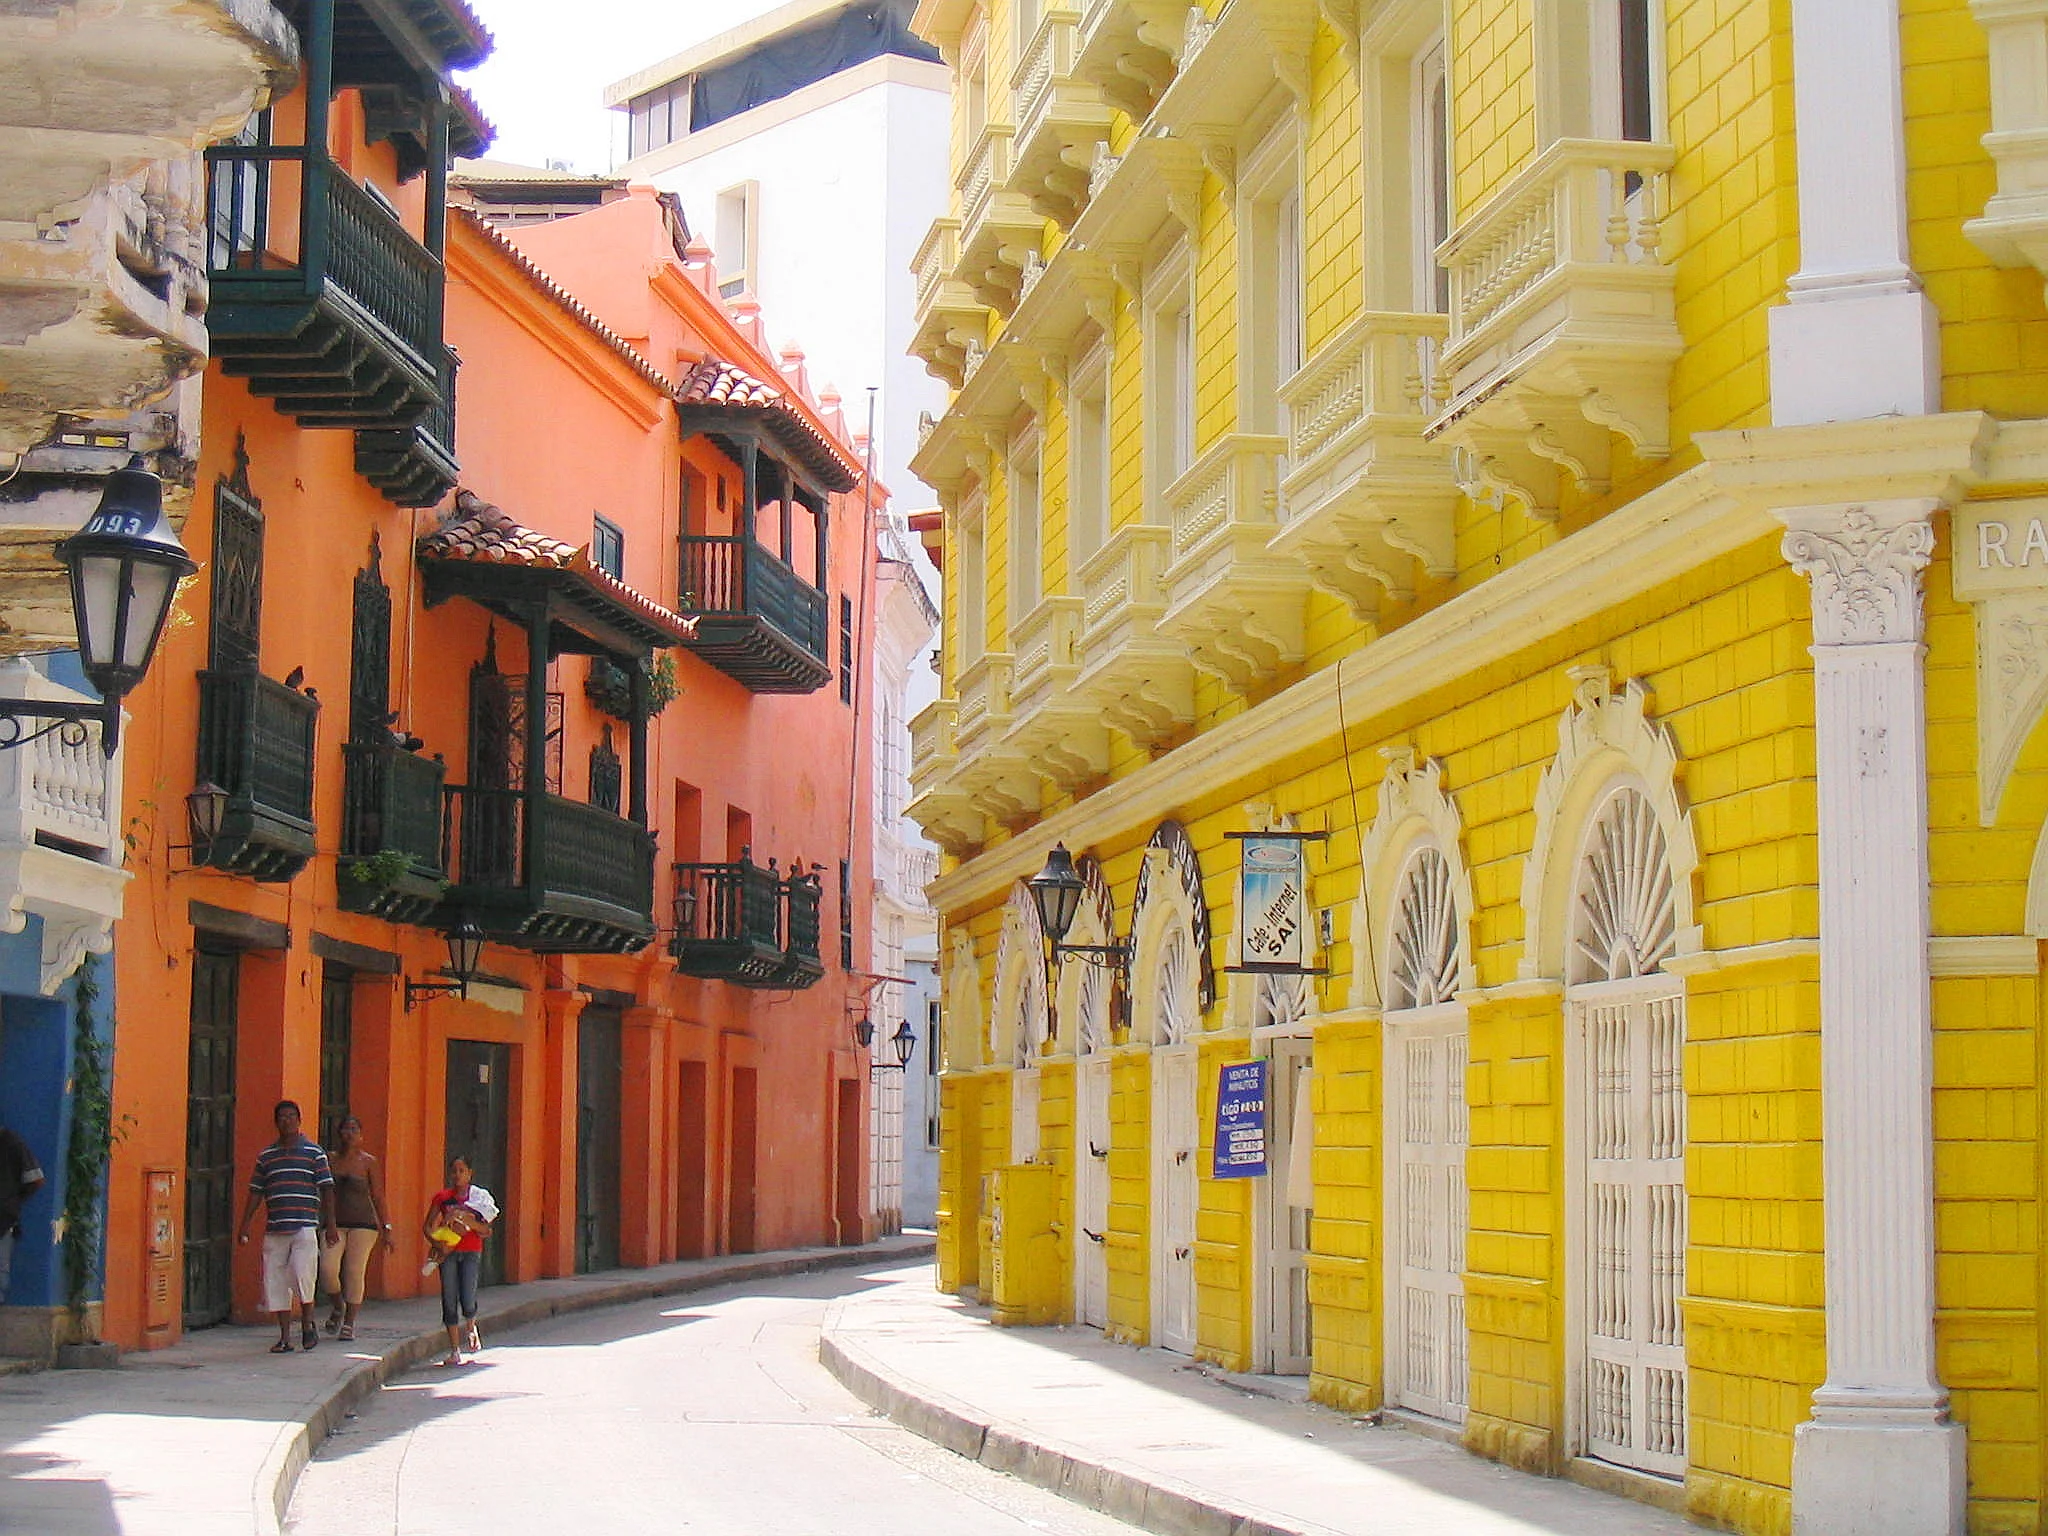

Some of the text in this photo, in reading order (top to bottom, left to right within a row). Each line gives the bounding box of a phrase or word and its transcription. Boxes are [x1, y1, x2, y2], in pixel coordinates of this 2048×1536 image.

[89, 515, 141, 535] 093
[1264, 882, 1298, 928] Internet
[1268, 918, 1297, 956] SAI
